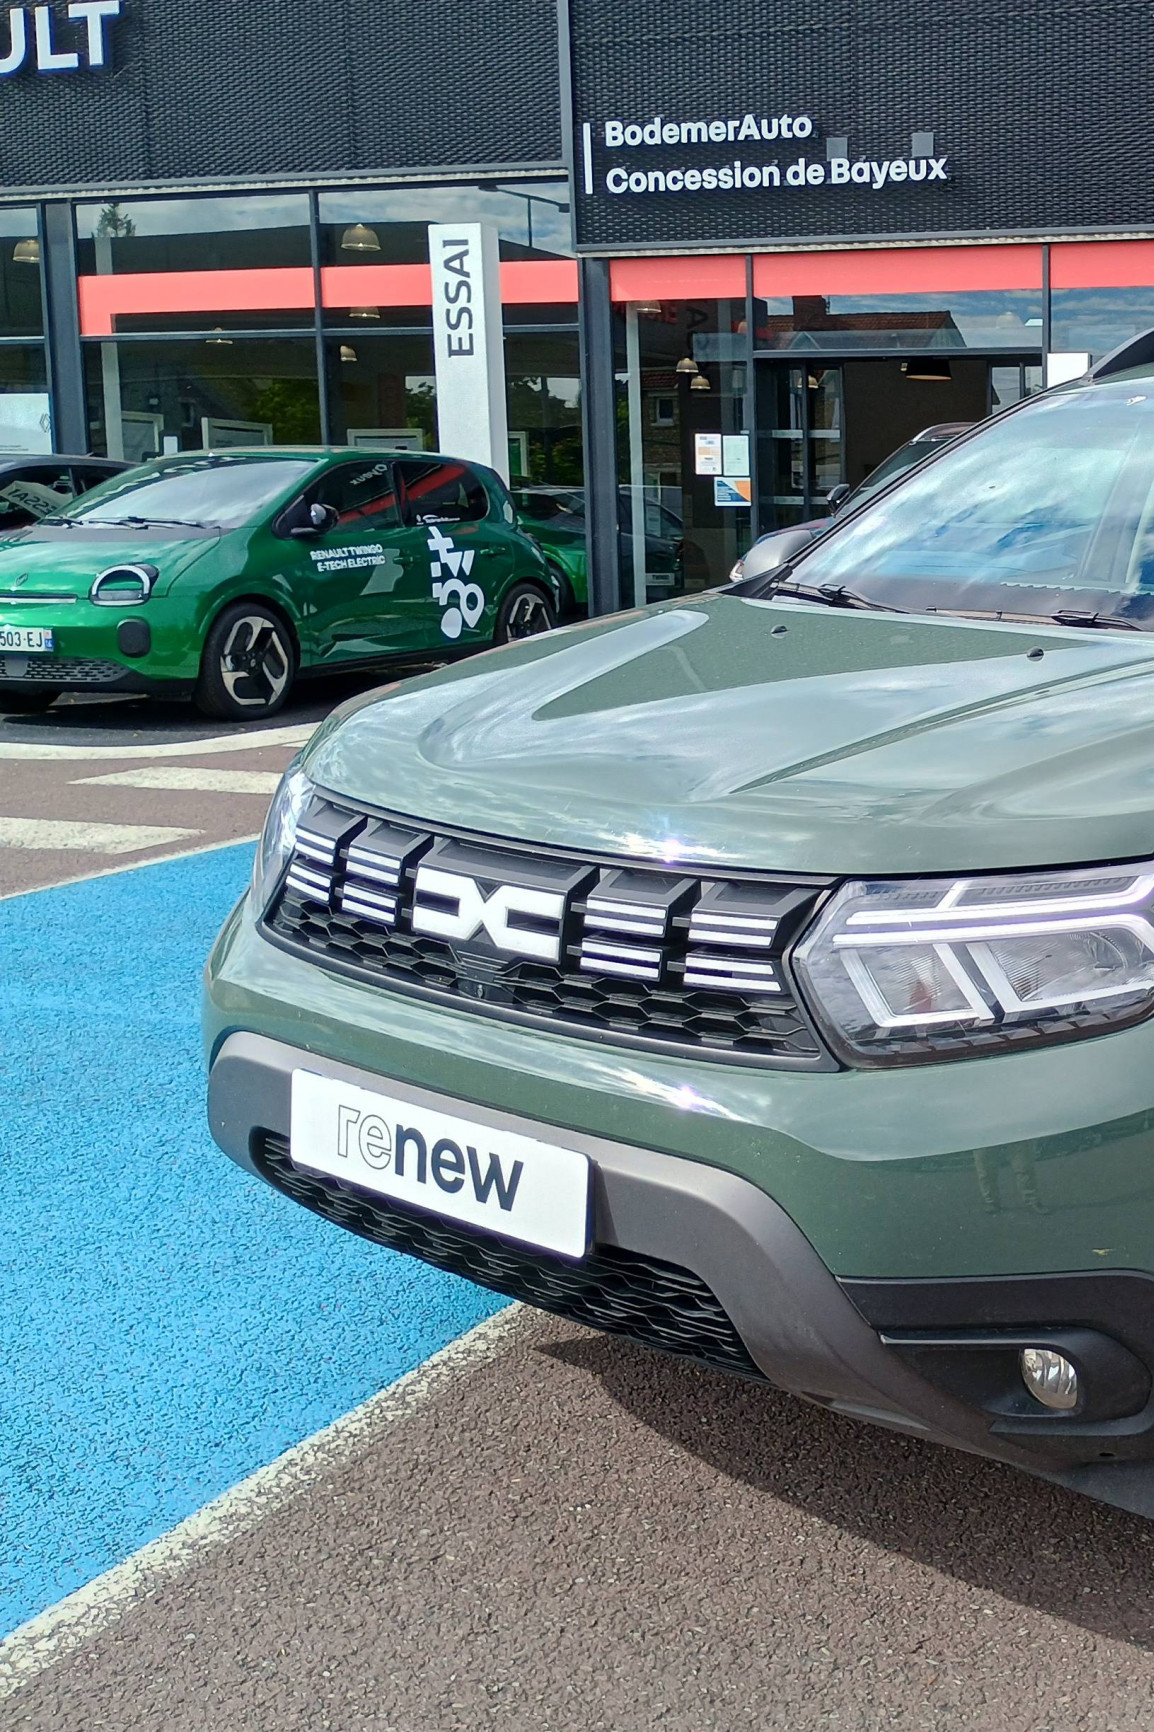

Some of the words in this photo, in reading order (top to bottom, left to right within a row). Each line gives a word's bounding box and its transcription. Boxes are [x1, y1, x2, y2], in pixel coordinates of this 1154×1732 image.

[605, 114, 813, 147] BodemerAuto
[606, 160, 781, 194] Concession
[786, 158, 825, 186] de
[831, 157, 948, 189] Bayeux
[442, 238, 474, 358] ESSAI
[310, 547, 349, 561] RENAULT
[349, 543, 383, 556] TWINGO
[316, 559, 348, 573] E-TECH
[347, 555, 386, 568] ELECTRIC
[337, 1104, 524, 1212] renew
